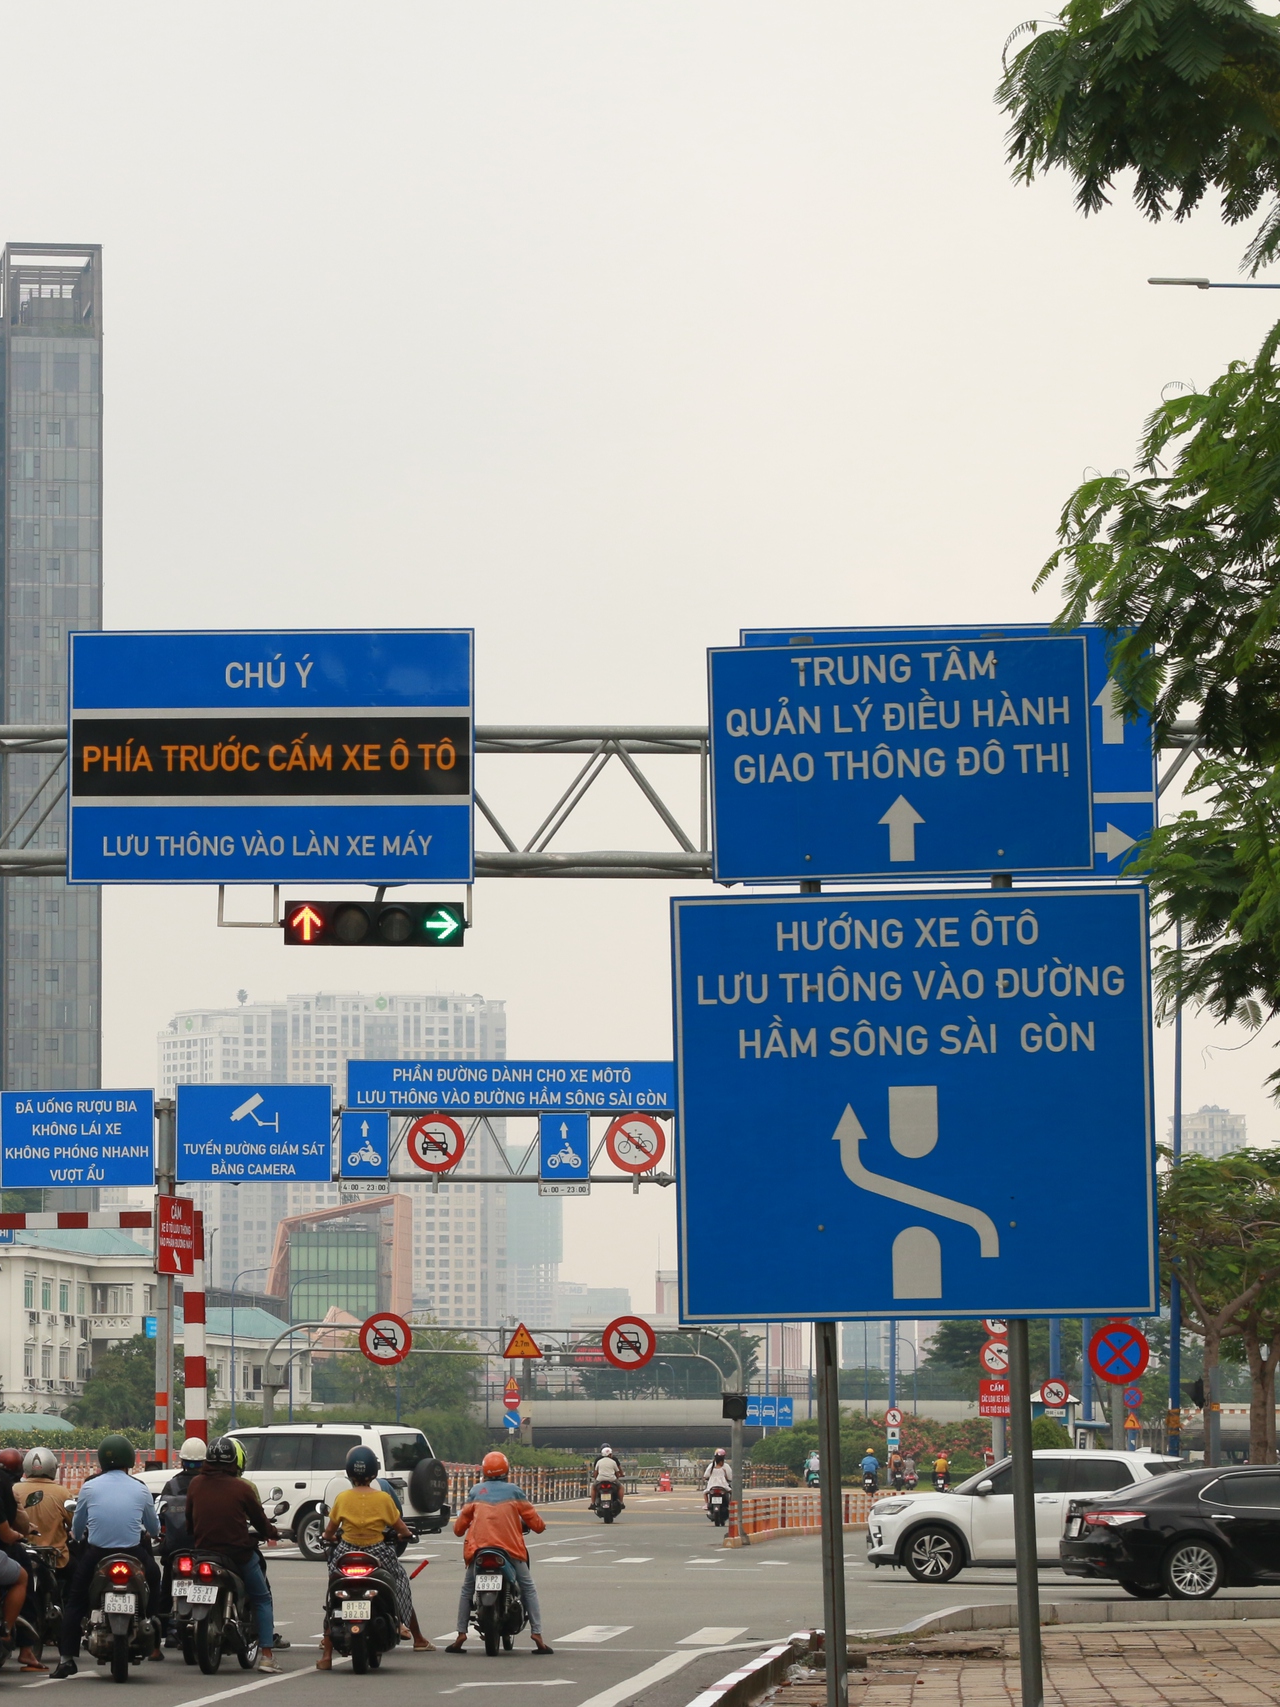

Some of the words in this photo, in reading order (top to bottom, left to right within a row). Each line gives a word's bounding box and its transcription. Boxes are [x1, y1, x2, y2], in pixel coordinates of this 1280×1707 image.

[225, 653, 286, 689] CHÚ
[294, 653, 314, 689] Ý
[790, 653, 912, 687] TRUNG
[920, 645, 998, 682] TÂM
[726, 696, 821, 738] QUẢN
[833, 696, 874, 734] LÝ
[882, 687, 961, 732] ĐIỀU
[972, 690, 1070, 728] HÀNH
[82, 737, 154, 772] PHÍA
[160, 735, 260, 772] TRƯỚC
[268, 732, 333, 772] CẤM
[341, 744, 381, 771] XE
[389, 737, 410, 771] Ô
[417, 737, 456, 771] TÔ
[734, 752, 815, 785] GIAO
[824, 742, 946, 781] THÔNG
[956, 738, 1005, 776] ĐÔ
[1012, 742, 1069, 778] THỊ
[102, 833, 149, 857] LƯU
[155, 830, 235, 857] THÔNG
[241, 829, 285, 857] VÀO
[292, 829, 339, 857] LÀN
[346, 835, 376, 856] XE
[382, 829, 433, 856] MÁY
[776, 911, 904, 952] HƯỚNG
[914, 917, 960, 948] XE
[970, 908, 1039, 947] ÔTÔ
[697, 971, 769, 1005] LƯU
[778, 965, 902, 1003] THÔNG
[912, 961, 985, 1001] VÀO
[995, 956, 1125, 999] ĐƯỜNG
[738, 1014, 817, 1059] HẦM
[829, 1019, 929, 1057] SÔNG
[939, 1015, 997, 1055] SÀI
[1020, 1012, 1095, 1053] GÒN
[393, 1063, 433, 1082] PHẦN
[436, 1064, 488, 1082] ĐƯỜNG
[491, 1065, 533, 1083] DÀNH
[536, 1068, 567, 1083] CHO
[569, 1069, 589, 1083] XE
[591, 1066, 632, 1083] MÔTÔ
[15, 1099, 34, 1114] ĐÃ
[38, 1097, 74, 1114] UỐNG
[76, 1099, 113, 1115] RƯỢU
[115, 1100, 138, 1113] BIA
[357, 1089, 386, 1104] LƯU
[389, 1087, 438, 1105] THÔNG
[441, 1087, 471, 1105] VÀO
[473, 1087, 526, 1105] ĐƯỜNG
[529, 1085, 562, 1105] HẦM
[564, 1088, 605, 1106] SÔNG
[608, 1088, 632, 1106] SÀI
[636, 1088, 667, 1106] GÒN
[32, 1121, 78, 1136] KHÔNG
[80, 1119, 102, 1136] LÁI
[105, 1122, 122, 1135] XE
[5, 1144, 51, 1160] KHÔNG
[53, 1143, 99, 1159] PHÓNG
[102, 1145, 149, 1158] NHANH
[183, 1138, 222, 1155] TUYẾN
[224, 1140, 267, 1156] ĐƯỜNG
[269, 1140, 299, 1156] GIÁM
[301, 1141, 326, 1156] SÁT
[49, 1167, 84, 1184] VƯỢT
[86, 1163, 105, 1181] ẨU
[211, 1158, 245, 1175] BẰNG
[247, 1163, 297, 1175] CAMERA
[171, 1200, 182, 1220] CẤM
[990, 1382, 1004, 1391] CẤM
[107, 1603, 133, 1612] 653.38
